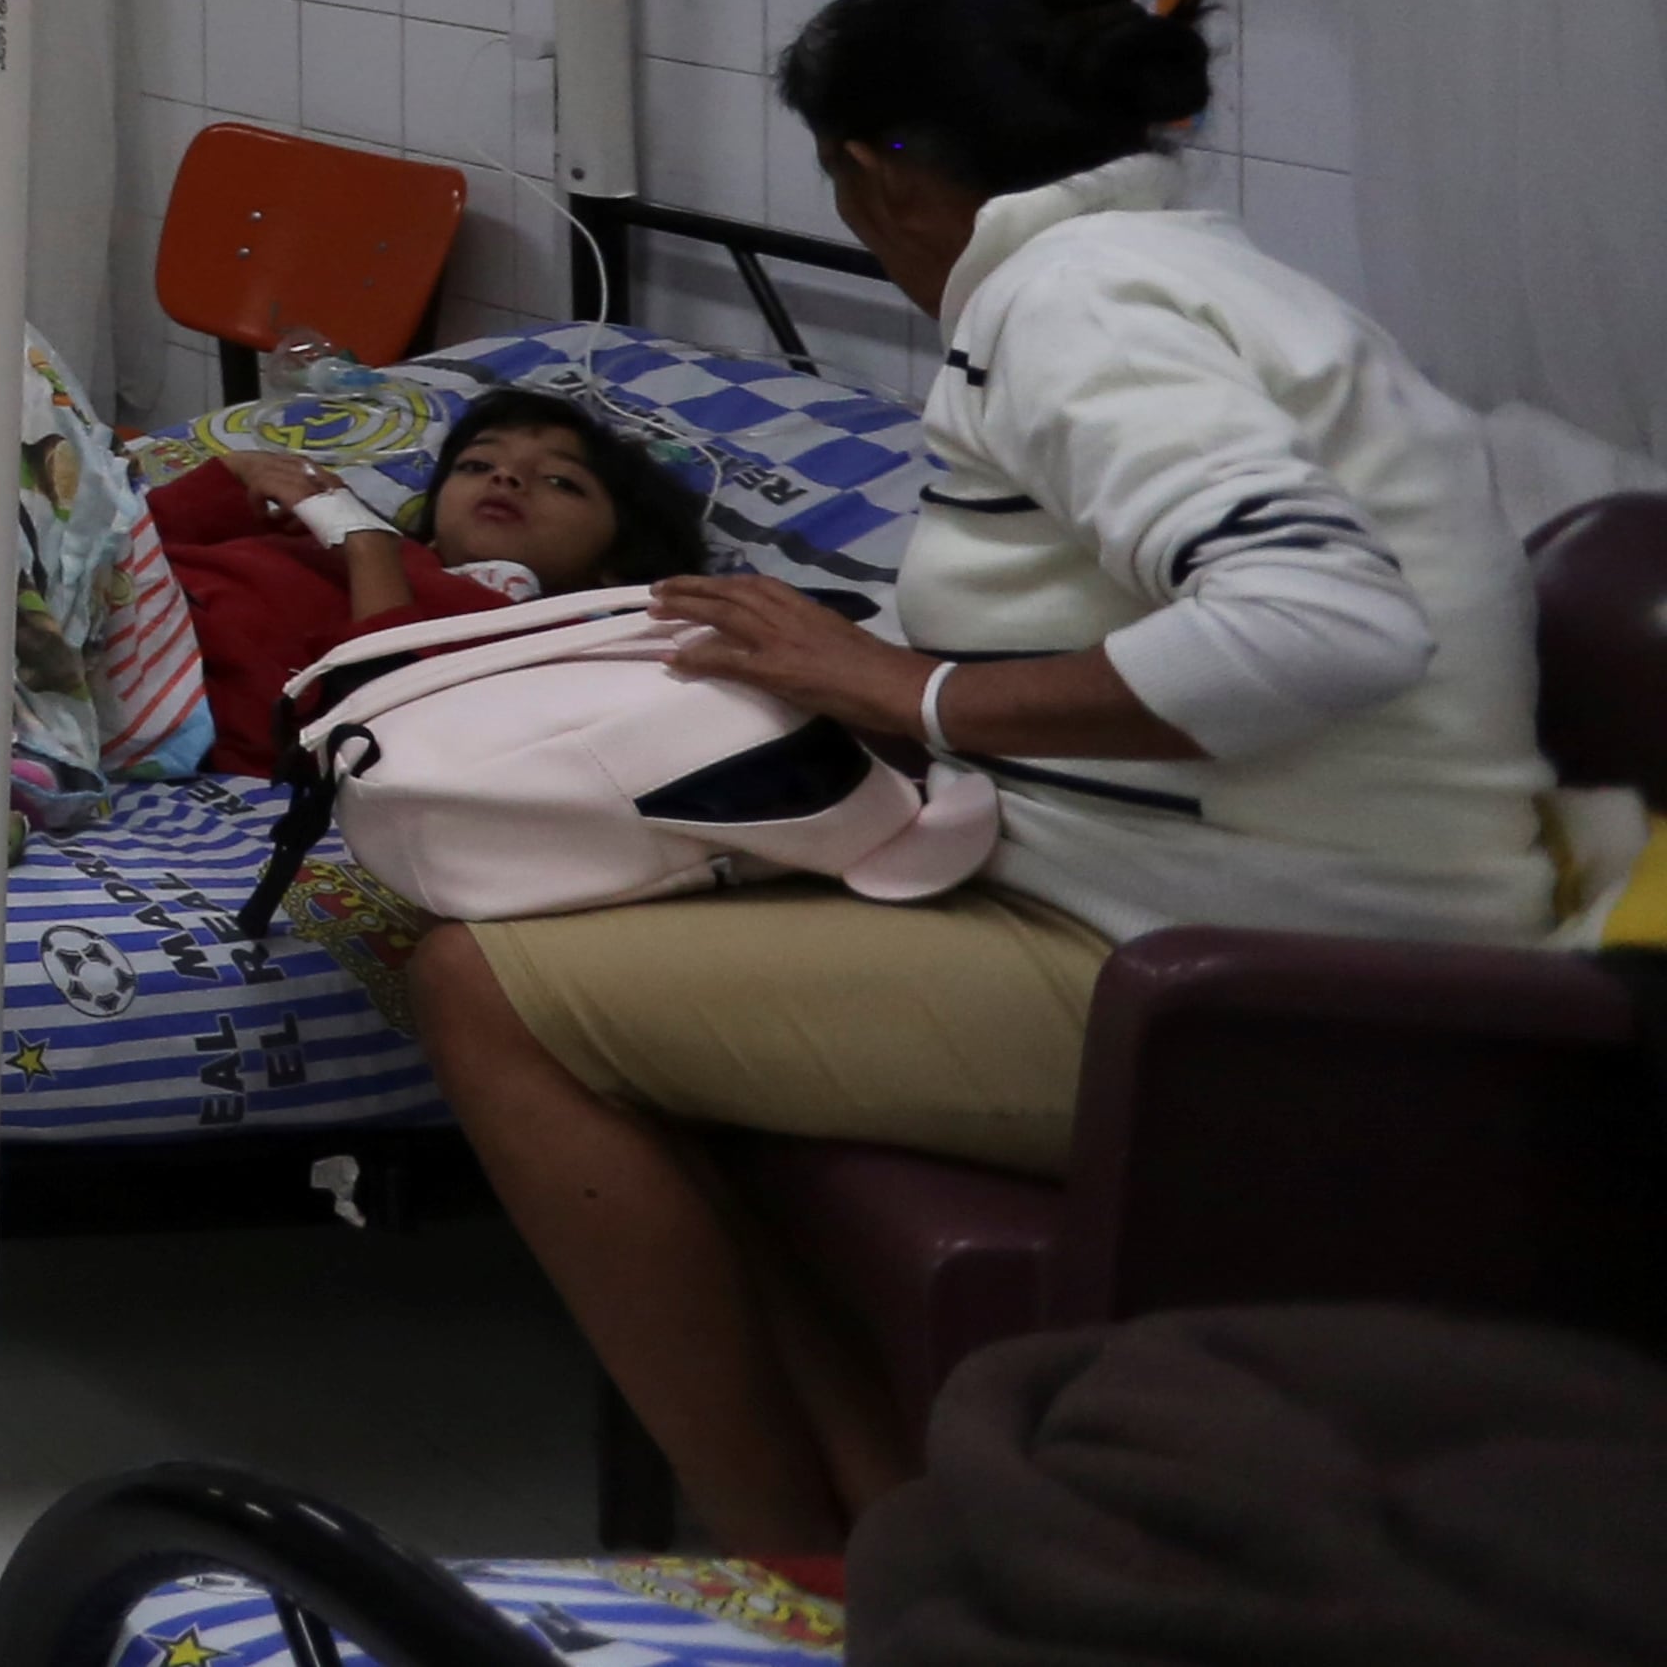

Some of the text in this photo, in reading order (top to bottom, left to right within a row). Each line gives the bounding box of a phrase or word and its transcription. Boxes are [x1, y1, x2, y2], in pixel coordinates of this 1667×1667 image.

[150, 872, 306, 1084] EL REAL
[195, 1014, 246, 1125] EAL
